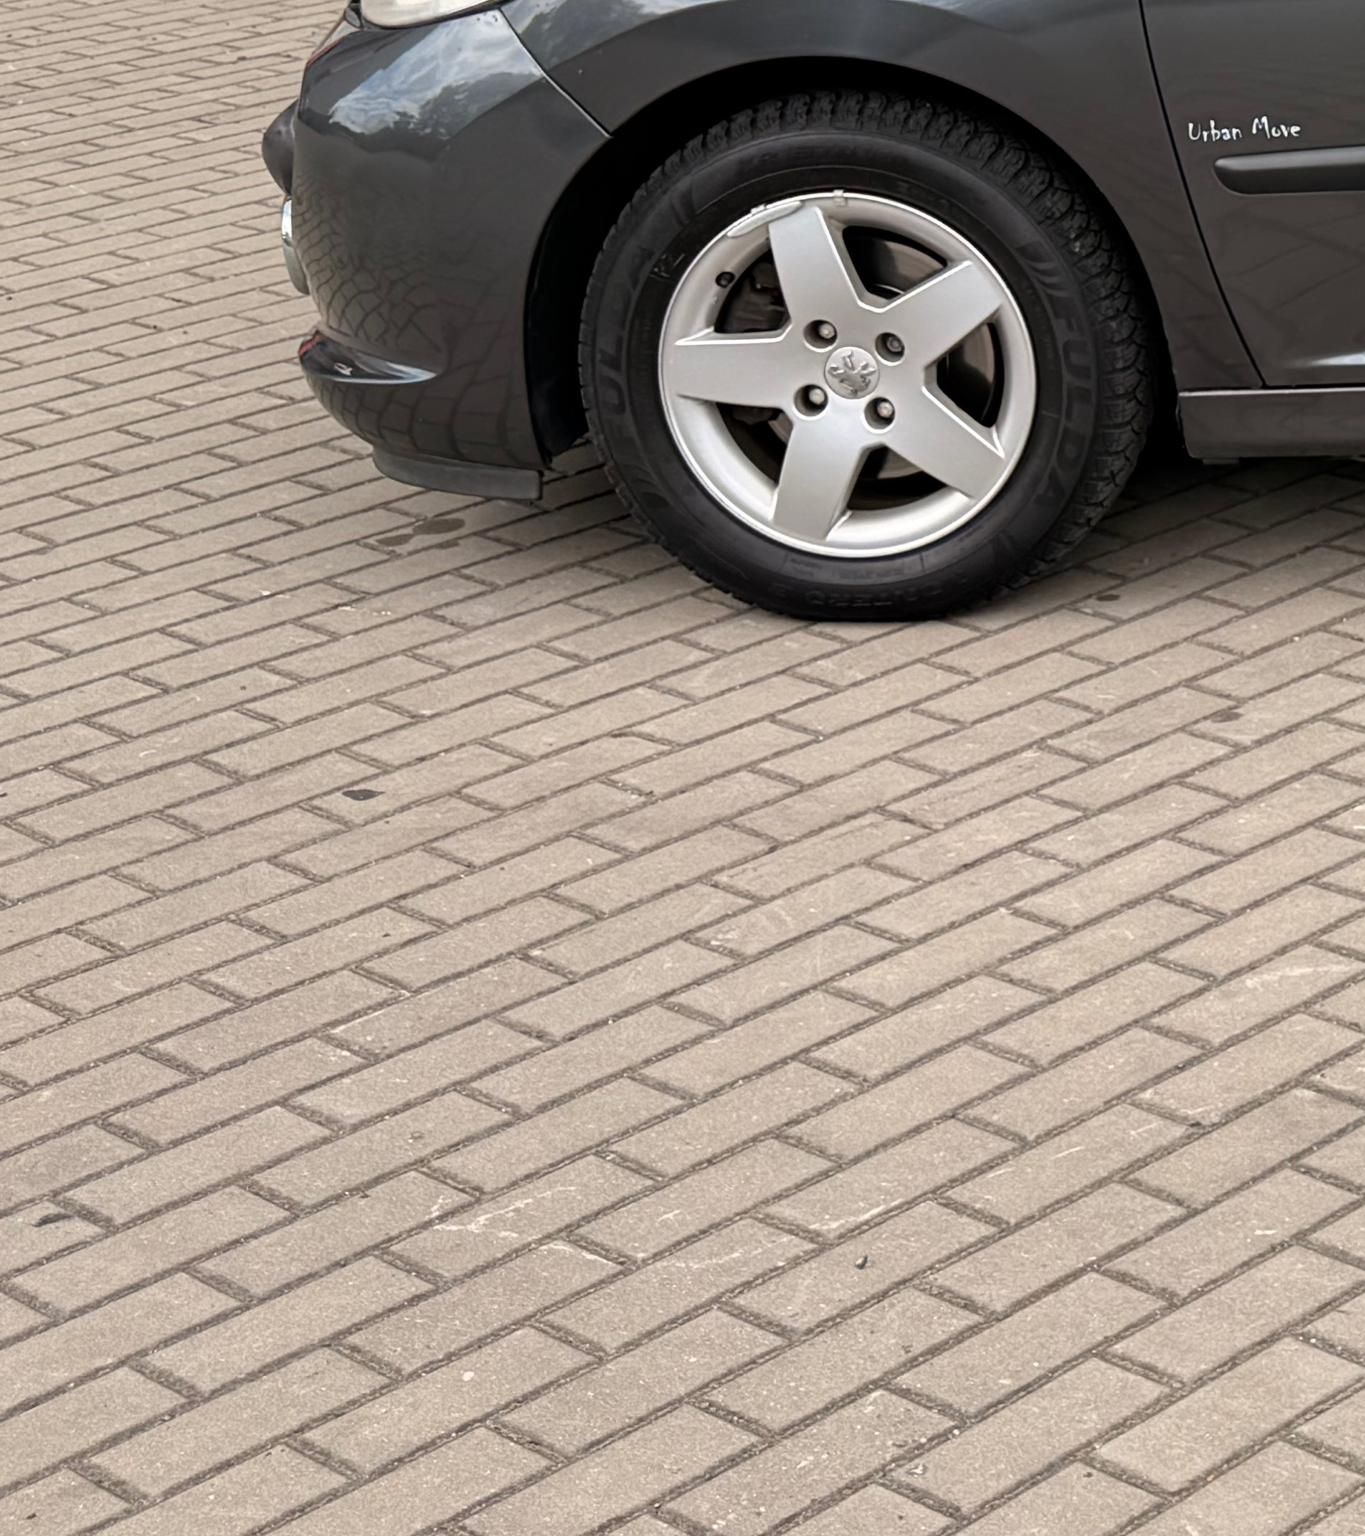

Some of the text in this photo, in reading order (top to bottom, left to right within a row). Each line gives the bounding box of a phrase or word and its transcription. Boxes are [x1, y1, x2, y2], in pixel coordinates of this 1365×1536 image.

[1188, 115, 1302, 142] Urban Move
[1034, 306, 1093, 506] FULDA
